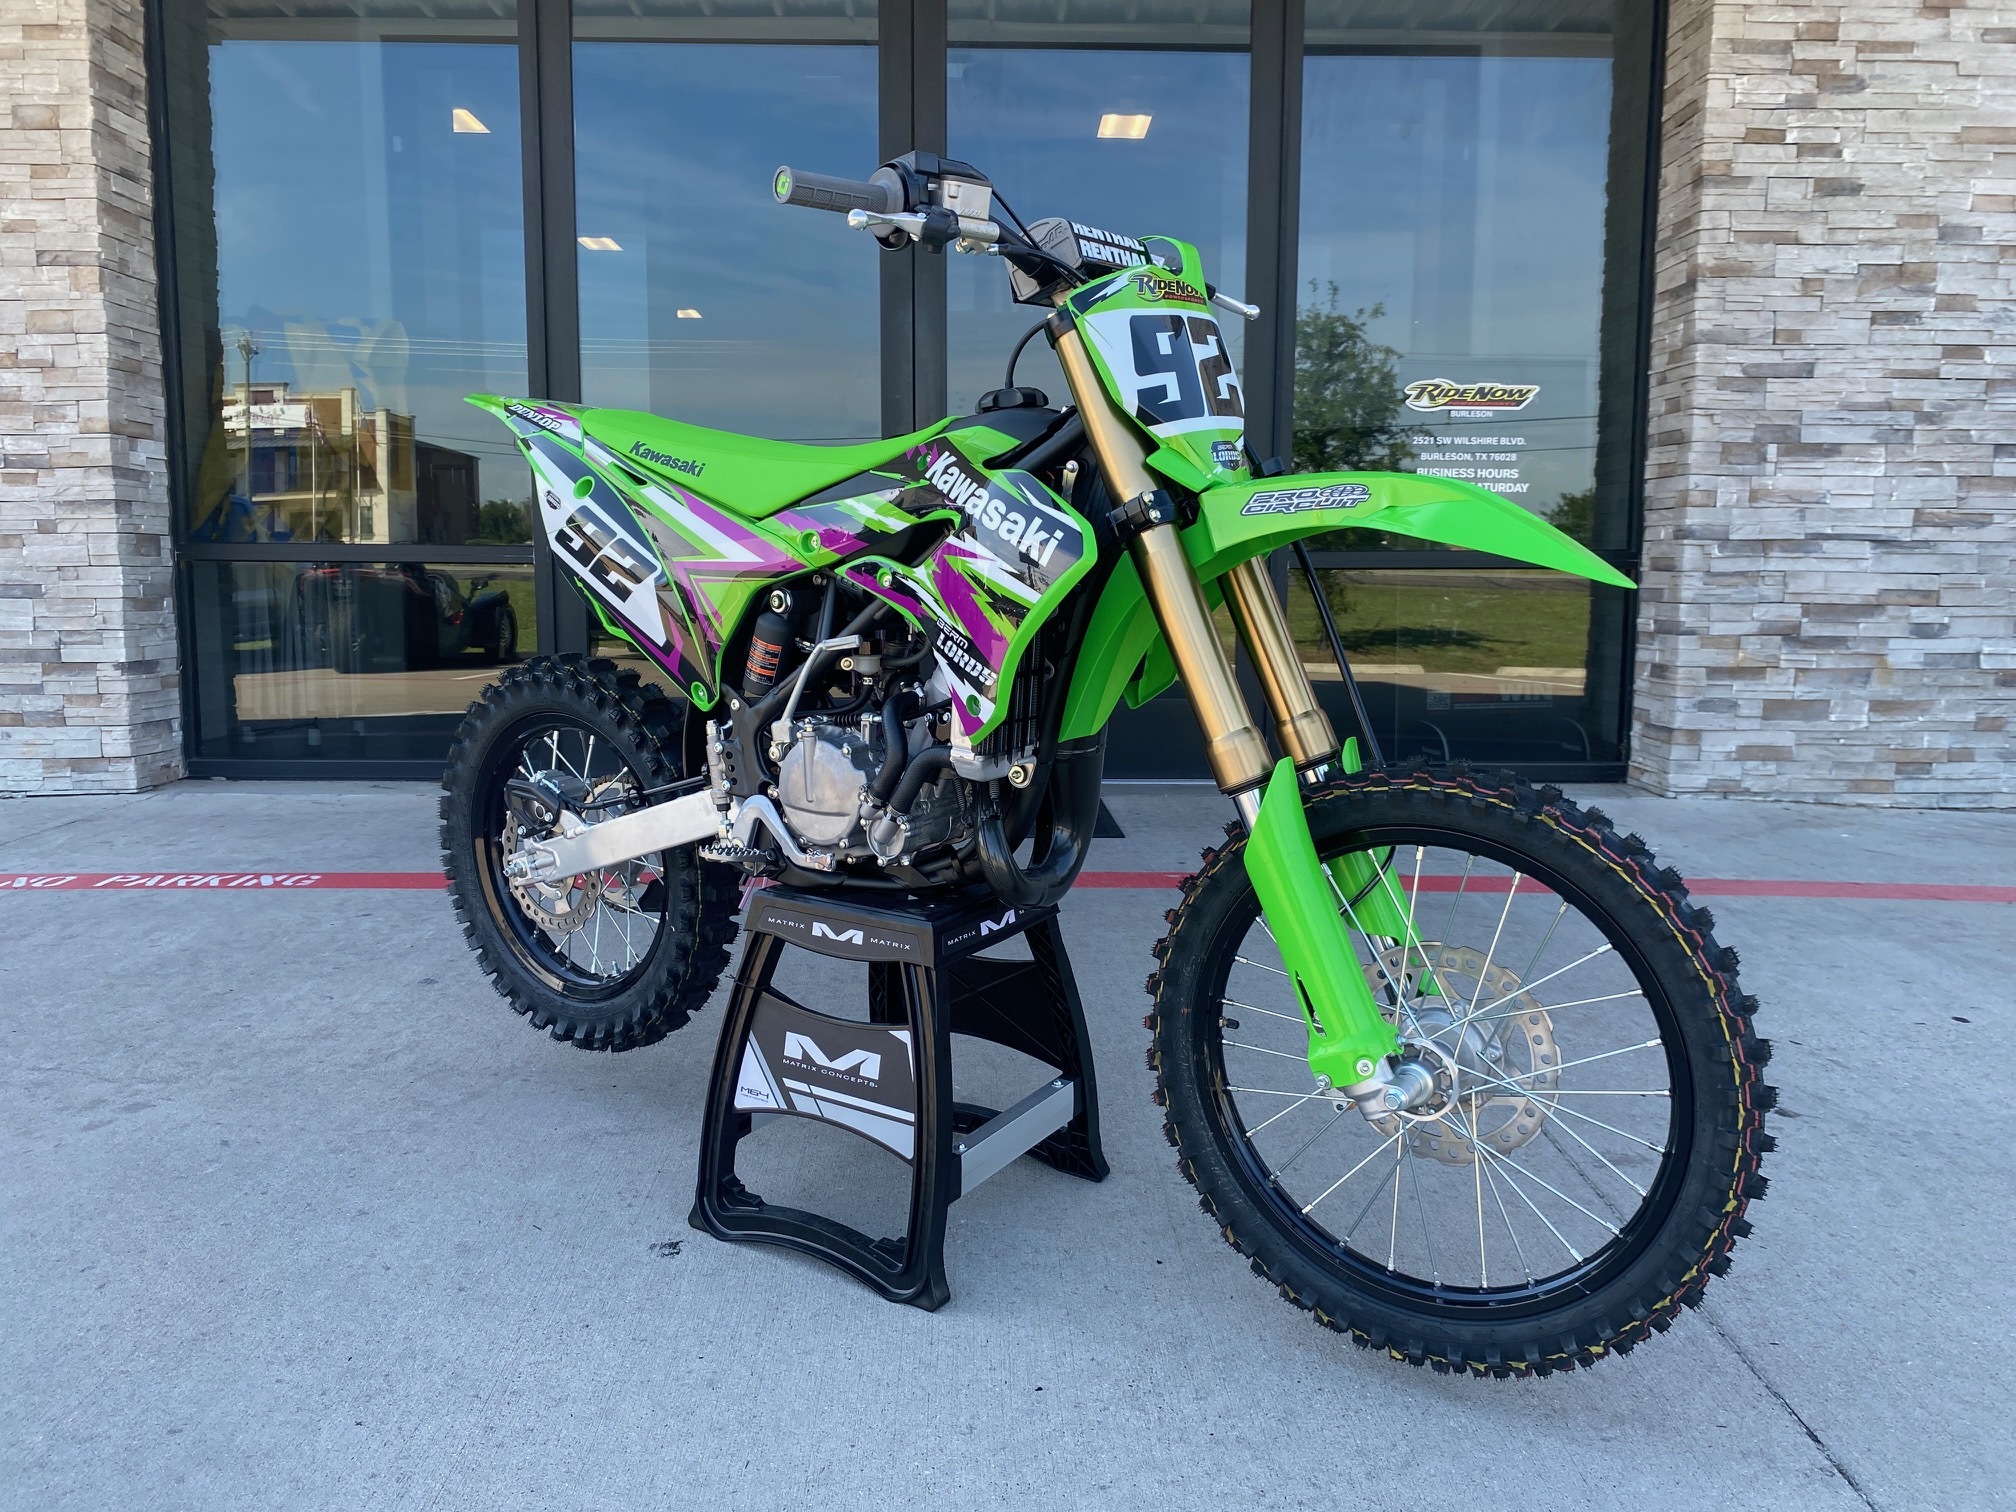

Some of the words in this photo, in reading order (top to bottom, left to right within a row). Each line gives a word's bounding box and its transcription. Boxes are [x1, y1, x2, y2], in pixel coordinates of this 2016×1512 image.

[1129, 314, 1245, 427] 92
[507, 404, 562, 430] DUNLOP
[1449, 410, 1493, 418] BURLESON
[1412, 436, 1434, 445] 2521
[1436, 436, 1453, 445] SW
[1454, 436, 1499, 446] WILSHIRE
[1500, 437, 1527, 446] BLVD.
[628, 440, 707, 478] Kawasaki
[1420, 452, 1473, 462] BURLESON,
[1475, 453, 1488, 461] TX
[1489, 453, 1517, 462] 76028
[1416, 467, 1475, 479] BUSINESS
[1477, 468, 1519, 479] HOURS
[1469, 482, 1530, 493] ATURDAY
[924, 450, 1065, 568] Kawasaki
[1243, 495, 1369, 515] CIRCUIT
[554, 505, 658, 604] 92
[936, 617, 969, 650] BERM
[936, 631, 998, 687] LORDS
[93, 874, 322, 888] PARKING
[767, 917, 805, 930] MATRIX
[870, 937, 911, 951] MATRIX
[947, 930, 976, 946] MATRIX
[782, 1058, 817, 1072] MATRIX
